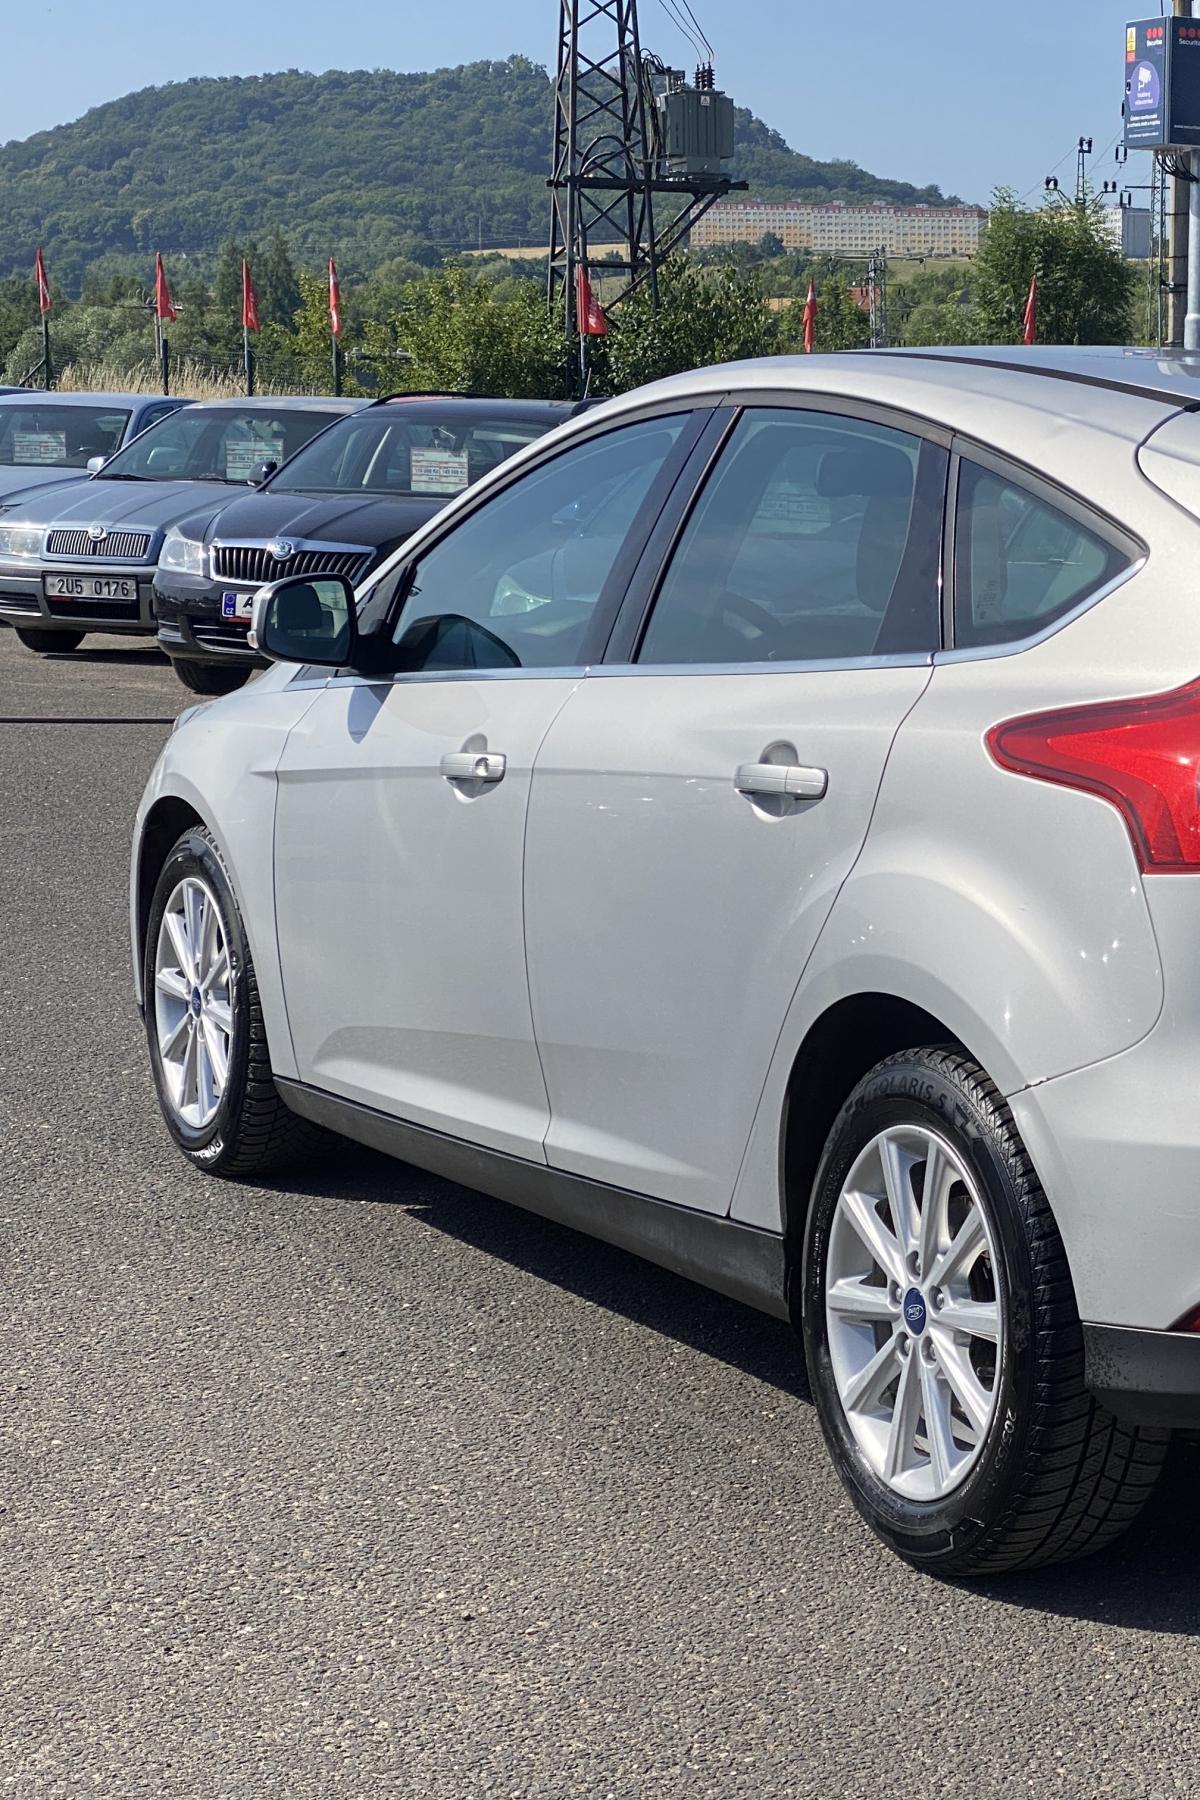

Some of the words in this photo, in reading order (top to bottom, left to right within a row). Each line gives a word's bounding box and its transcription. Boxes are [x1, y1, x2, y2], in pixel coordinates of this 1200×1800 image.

[56, 578, 82, 594] 2U5
[94, 580, 129, 597] 0176
[225, 607, 235, 615] CZ
